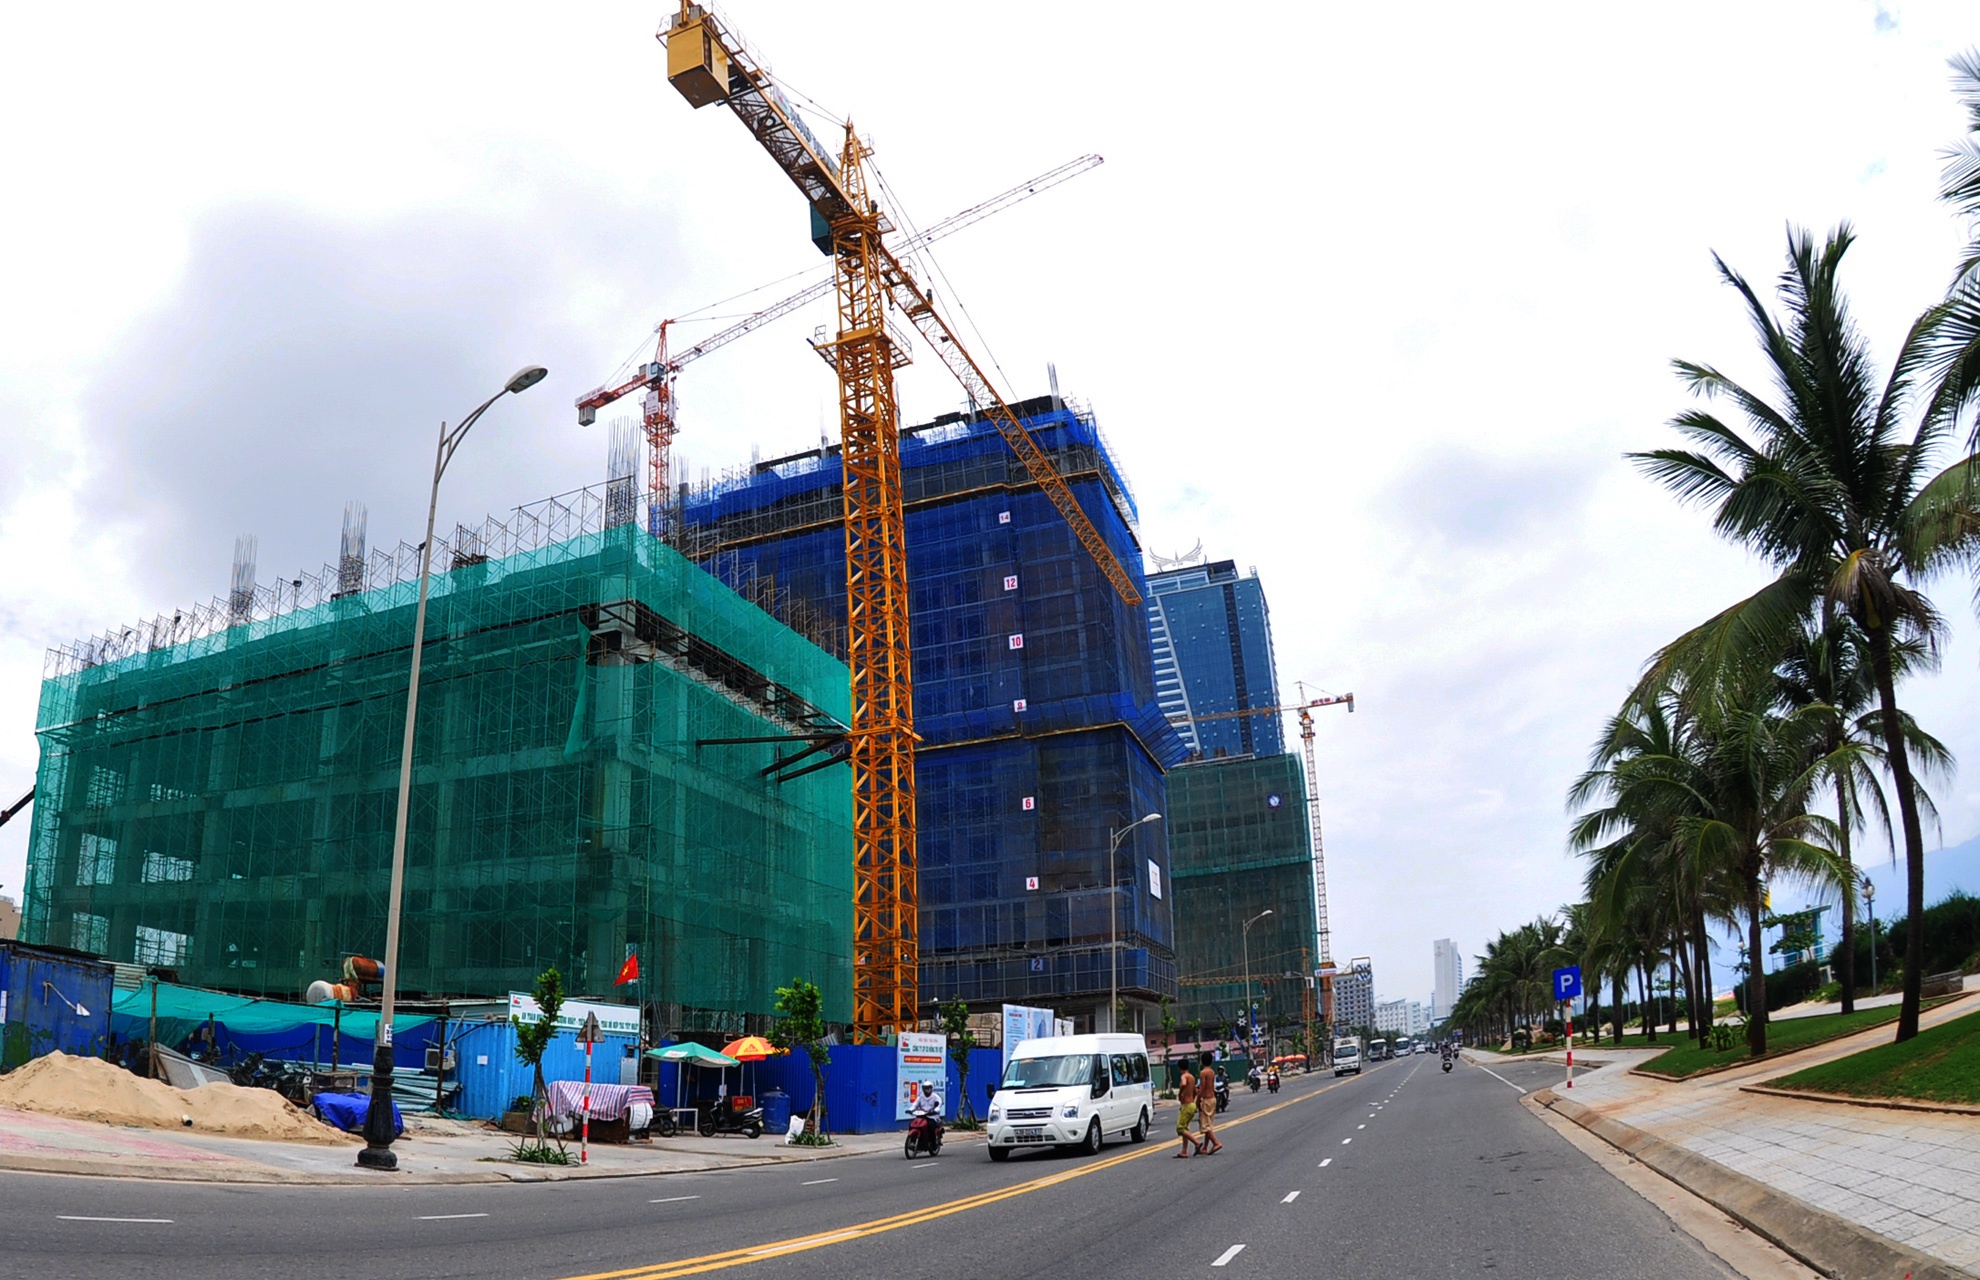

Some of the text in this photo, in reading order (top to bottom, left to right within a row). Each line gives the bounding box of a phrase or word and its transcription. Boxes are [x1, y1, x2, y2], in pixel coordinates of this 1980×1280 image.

[1006, 578, 1016, 587] 12
[1011, 637, 1021, 647] 10
[1025, 799, 1031, 808] 6
[1029, 879, 1035, 889] 4
[1034, 960, 1040, 970] 2
[1560, 974, 1574, 992] P
